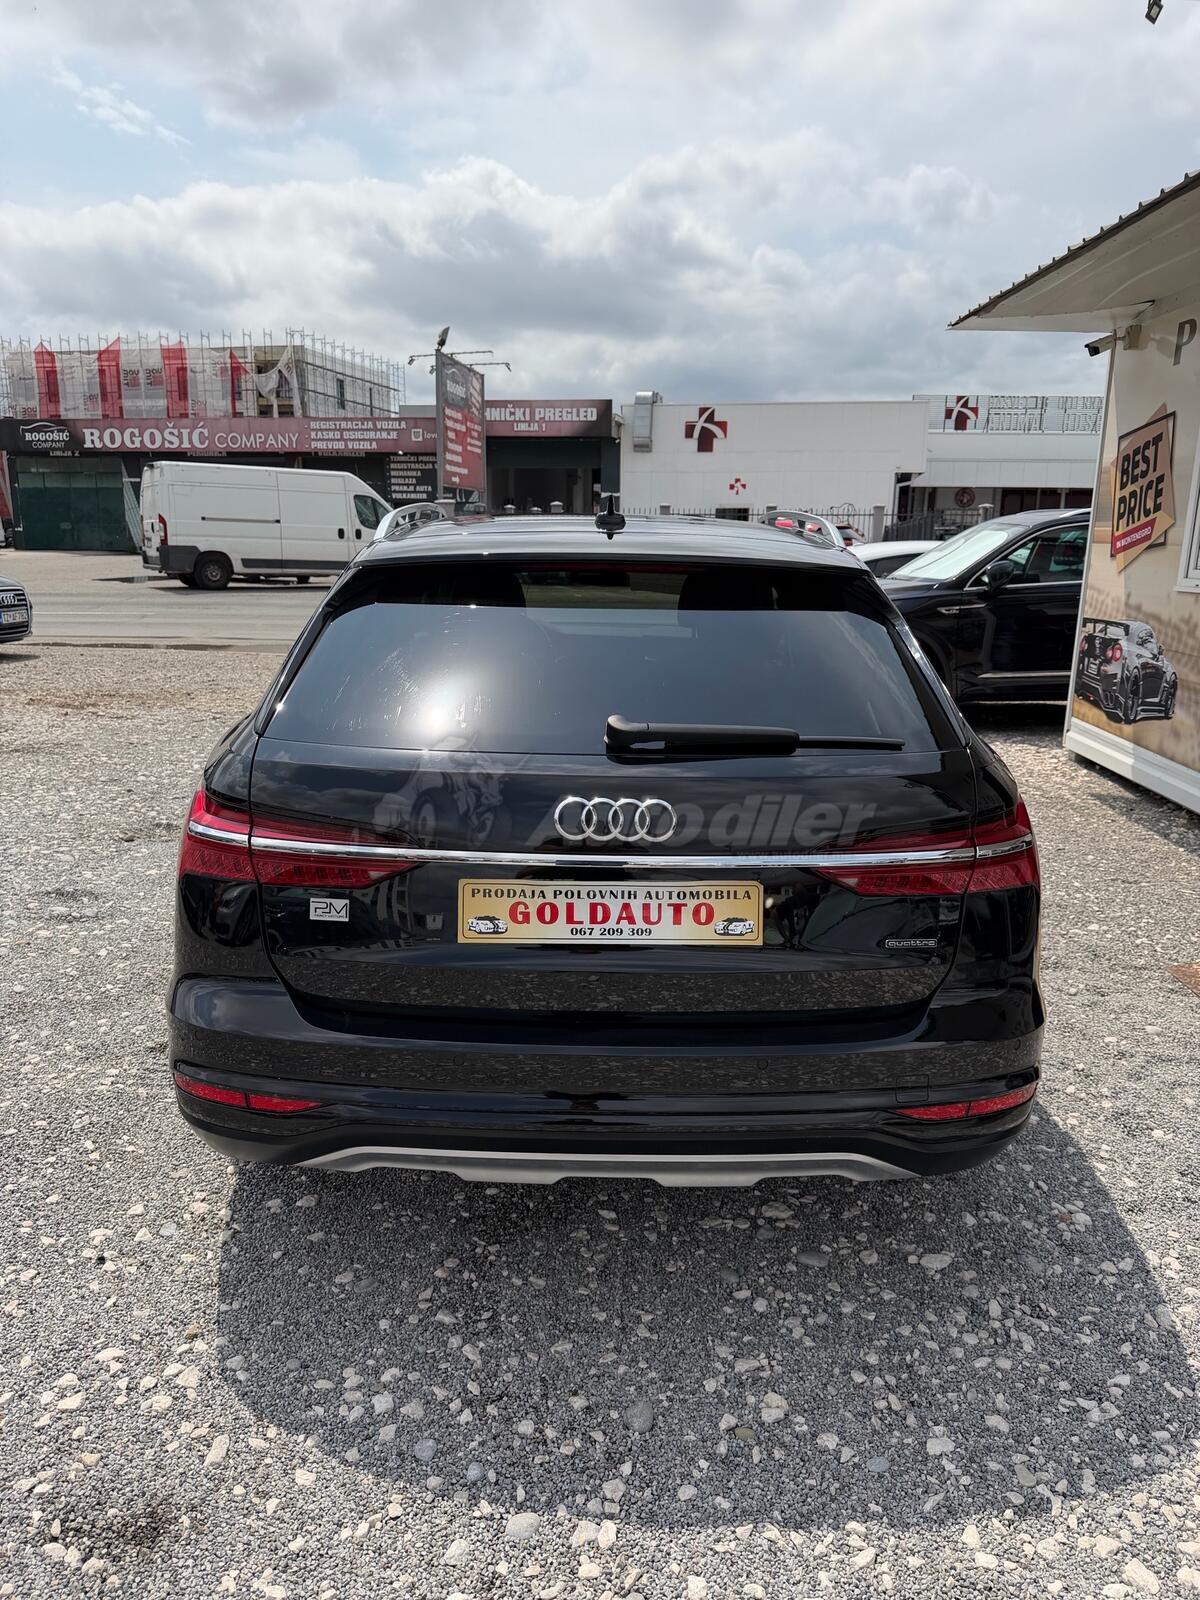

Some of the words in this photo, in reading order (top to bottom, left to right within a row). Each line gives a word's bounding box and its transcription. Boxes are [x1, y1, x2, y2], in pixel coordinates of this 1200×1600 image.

[535, 408, 598, 421] PREGLED
[310, 421, 374, 430] REGISTRACIJA
[376, 421, 407, 430] VOZILA
[25, 430, 70, 441] ROGOŠIĆ
[82, 422, 209, 449] ROGOŠIĆ
[214, 432, 299, 449] COMPANY
[310, 431, 341, 440] KASKO
[343, 431, 399, 440] OSIGURANJE
[32, 441, 65, 449] COMPANY
[311, 441, 345, 450] PREVOD
[347, 441, 378, 450] VOZILA
[1119, 431, 1163, 492] BEST
[1115, 472, 1165, 532] PRICE
[471, 888, 547, 900] PRODAJA
[553, 888, 637, 900] POLOVNIH
[644, 889, 752, 900] AUTOMOBILA
[508, 901, 715, 926] GOLDAUTO
[570, 927, 594, 937] 067
[599, 927, 624, 937] 209
[627, 927, 652, 937] 309
[888, 940, 935, 948] quattro
